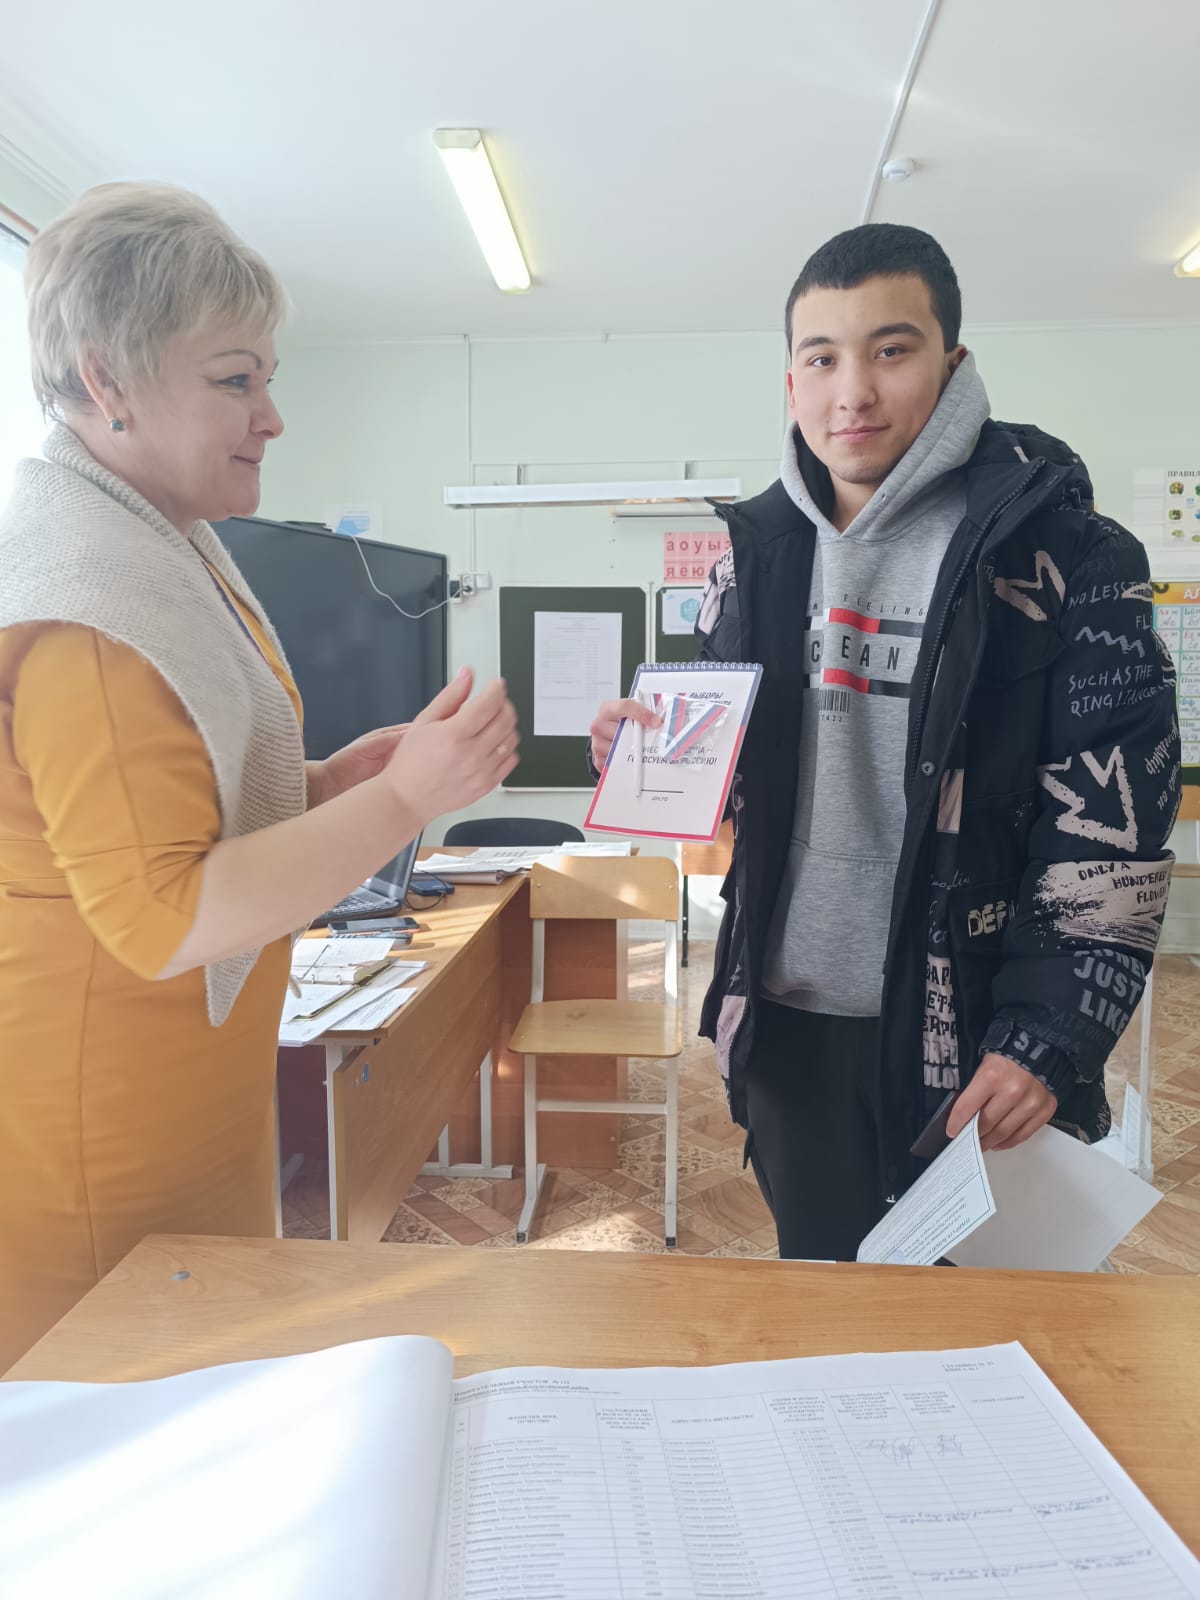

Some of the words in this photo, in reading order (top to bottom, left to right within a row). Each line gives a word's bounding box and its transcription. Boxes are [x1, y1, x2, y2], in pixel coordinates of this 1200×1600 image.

[666, 541, 675, 551] а
[680, 541, 689, 551] о
[694, 540, 703, 554] у
[708, 540, 720, 551] ы
[666, 567, 675, 577] я
[680, 563, 688, 577] ё
[692, 566, 705, 577] ю
[843, 593, 925, 617] FEELING
[1067, 592, 1087, 610] NO
[1136, 614, 1153, 630] FL
[1068, 672, 1109, 694] SUCH
[1112, 667, 1132, 686] AS
[1134, 664, 1154, 683] THE
[627, 754, 668, 764] ГОСУЕМ
[1077, 862, 1115, 881] ONLY
[1120, 862, 1131, 872] A
[1074, 956, 1143, 1006] JUST
[1079, 988, 1130, 1037] LIKE
